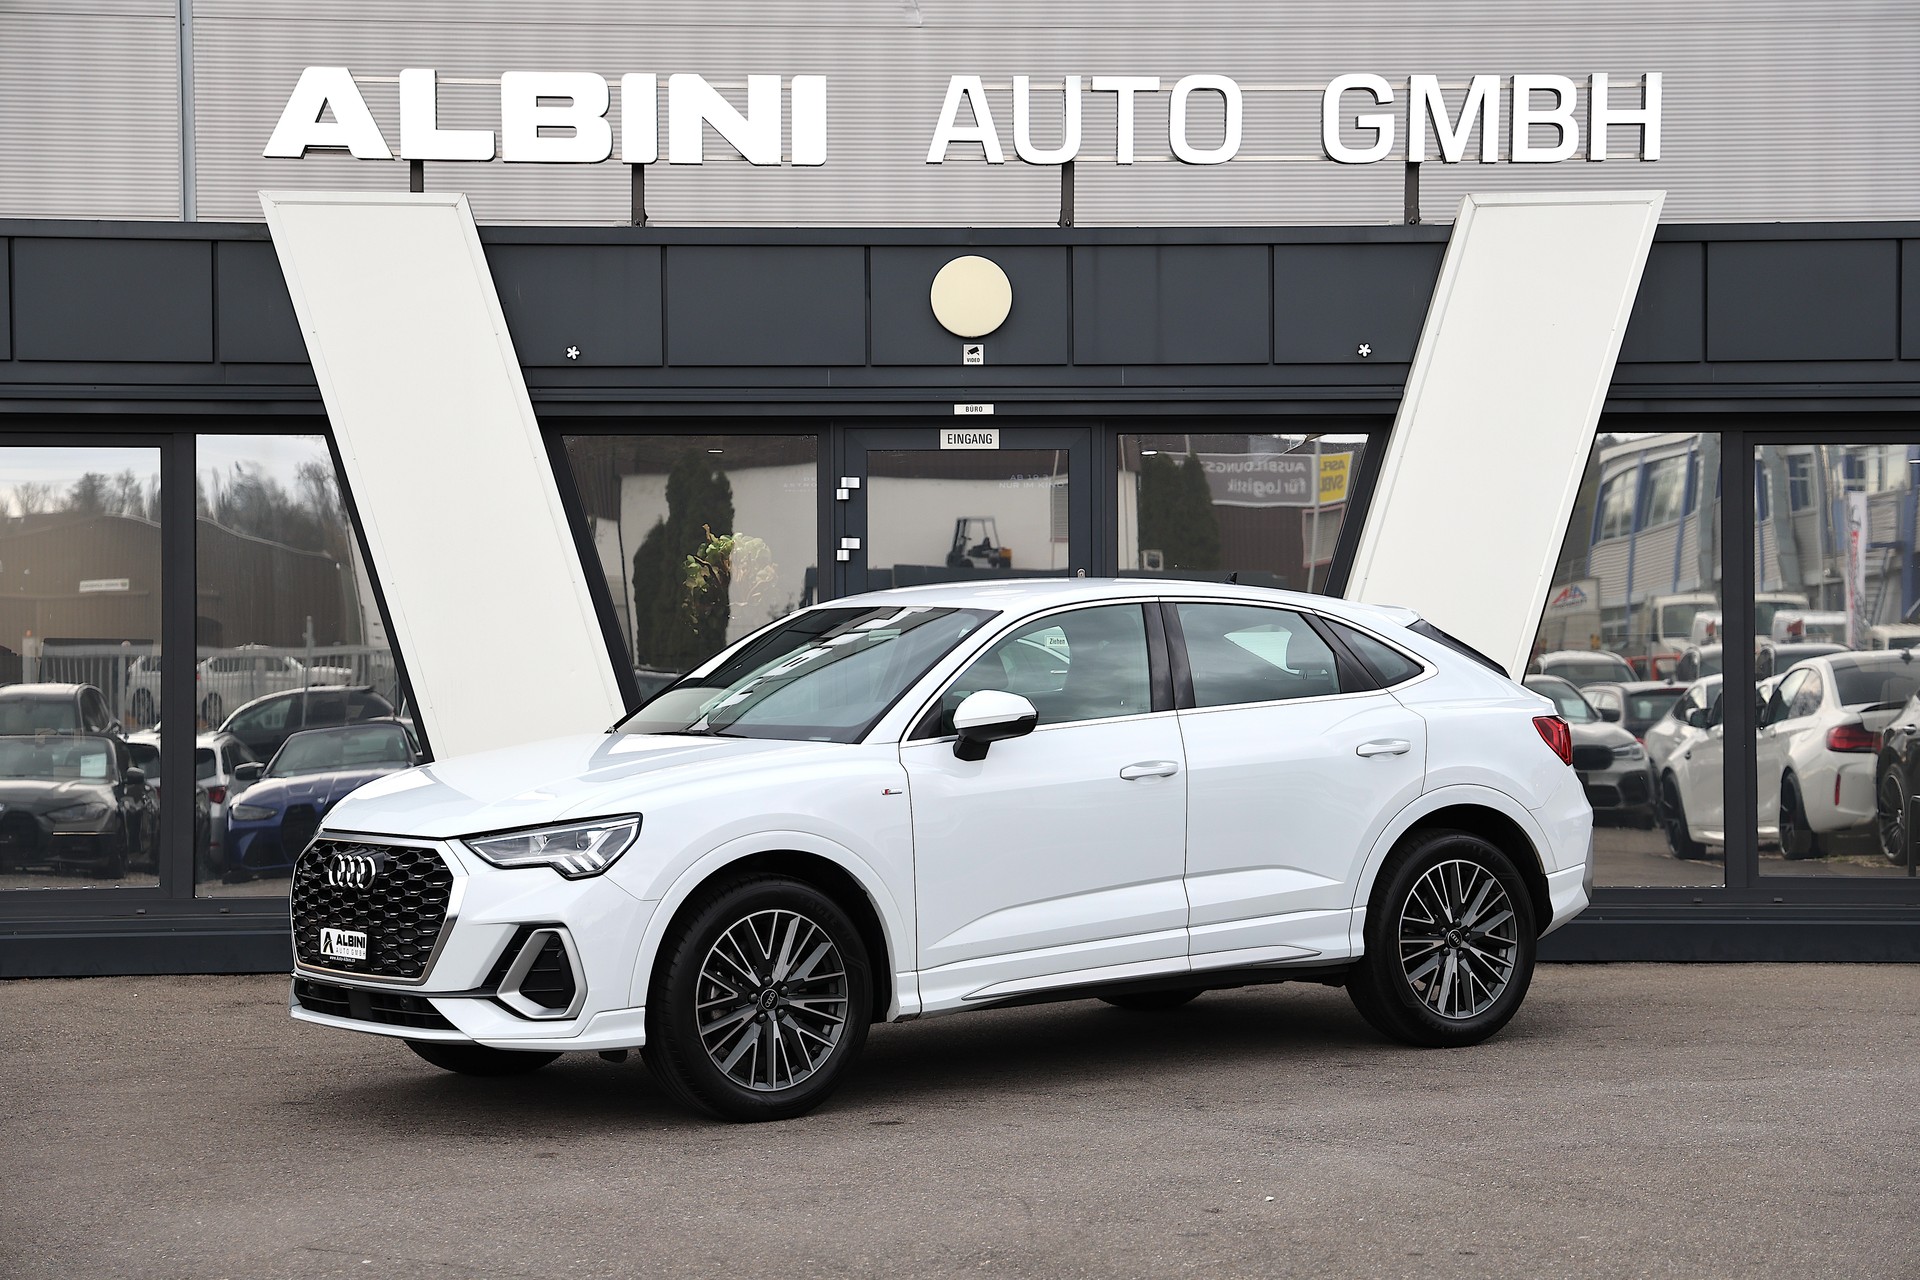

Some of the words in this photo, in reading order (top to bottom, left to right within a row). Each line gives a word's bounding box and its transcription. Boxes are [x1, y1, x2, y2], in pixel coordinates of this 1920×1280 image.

[263, 66, 828, 166] ALBINI
[926, 74, 1243, 165] AUTO
[1321, 72, 1663, 164] GMBH
[965, 404, 983, 413] BÜRO
[946, 432, 993, 445] EINGANG
[336, 934, 365, 948] ALBINI
